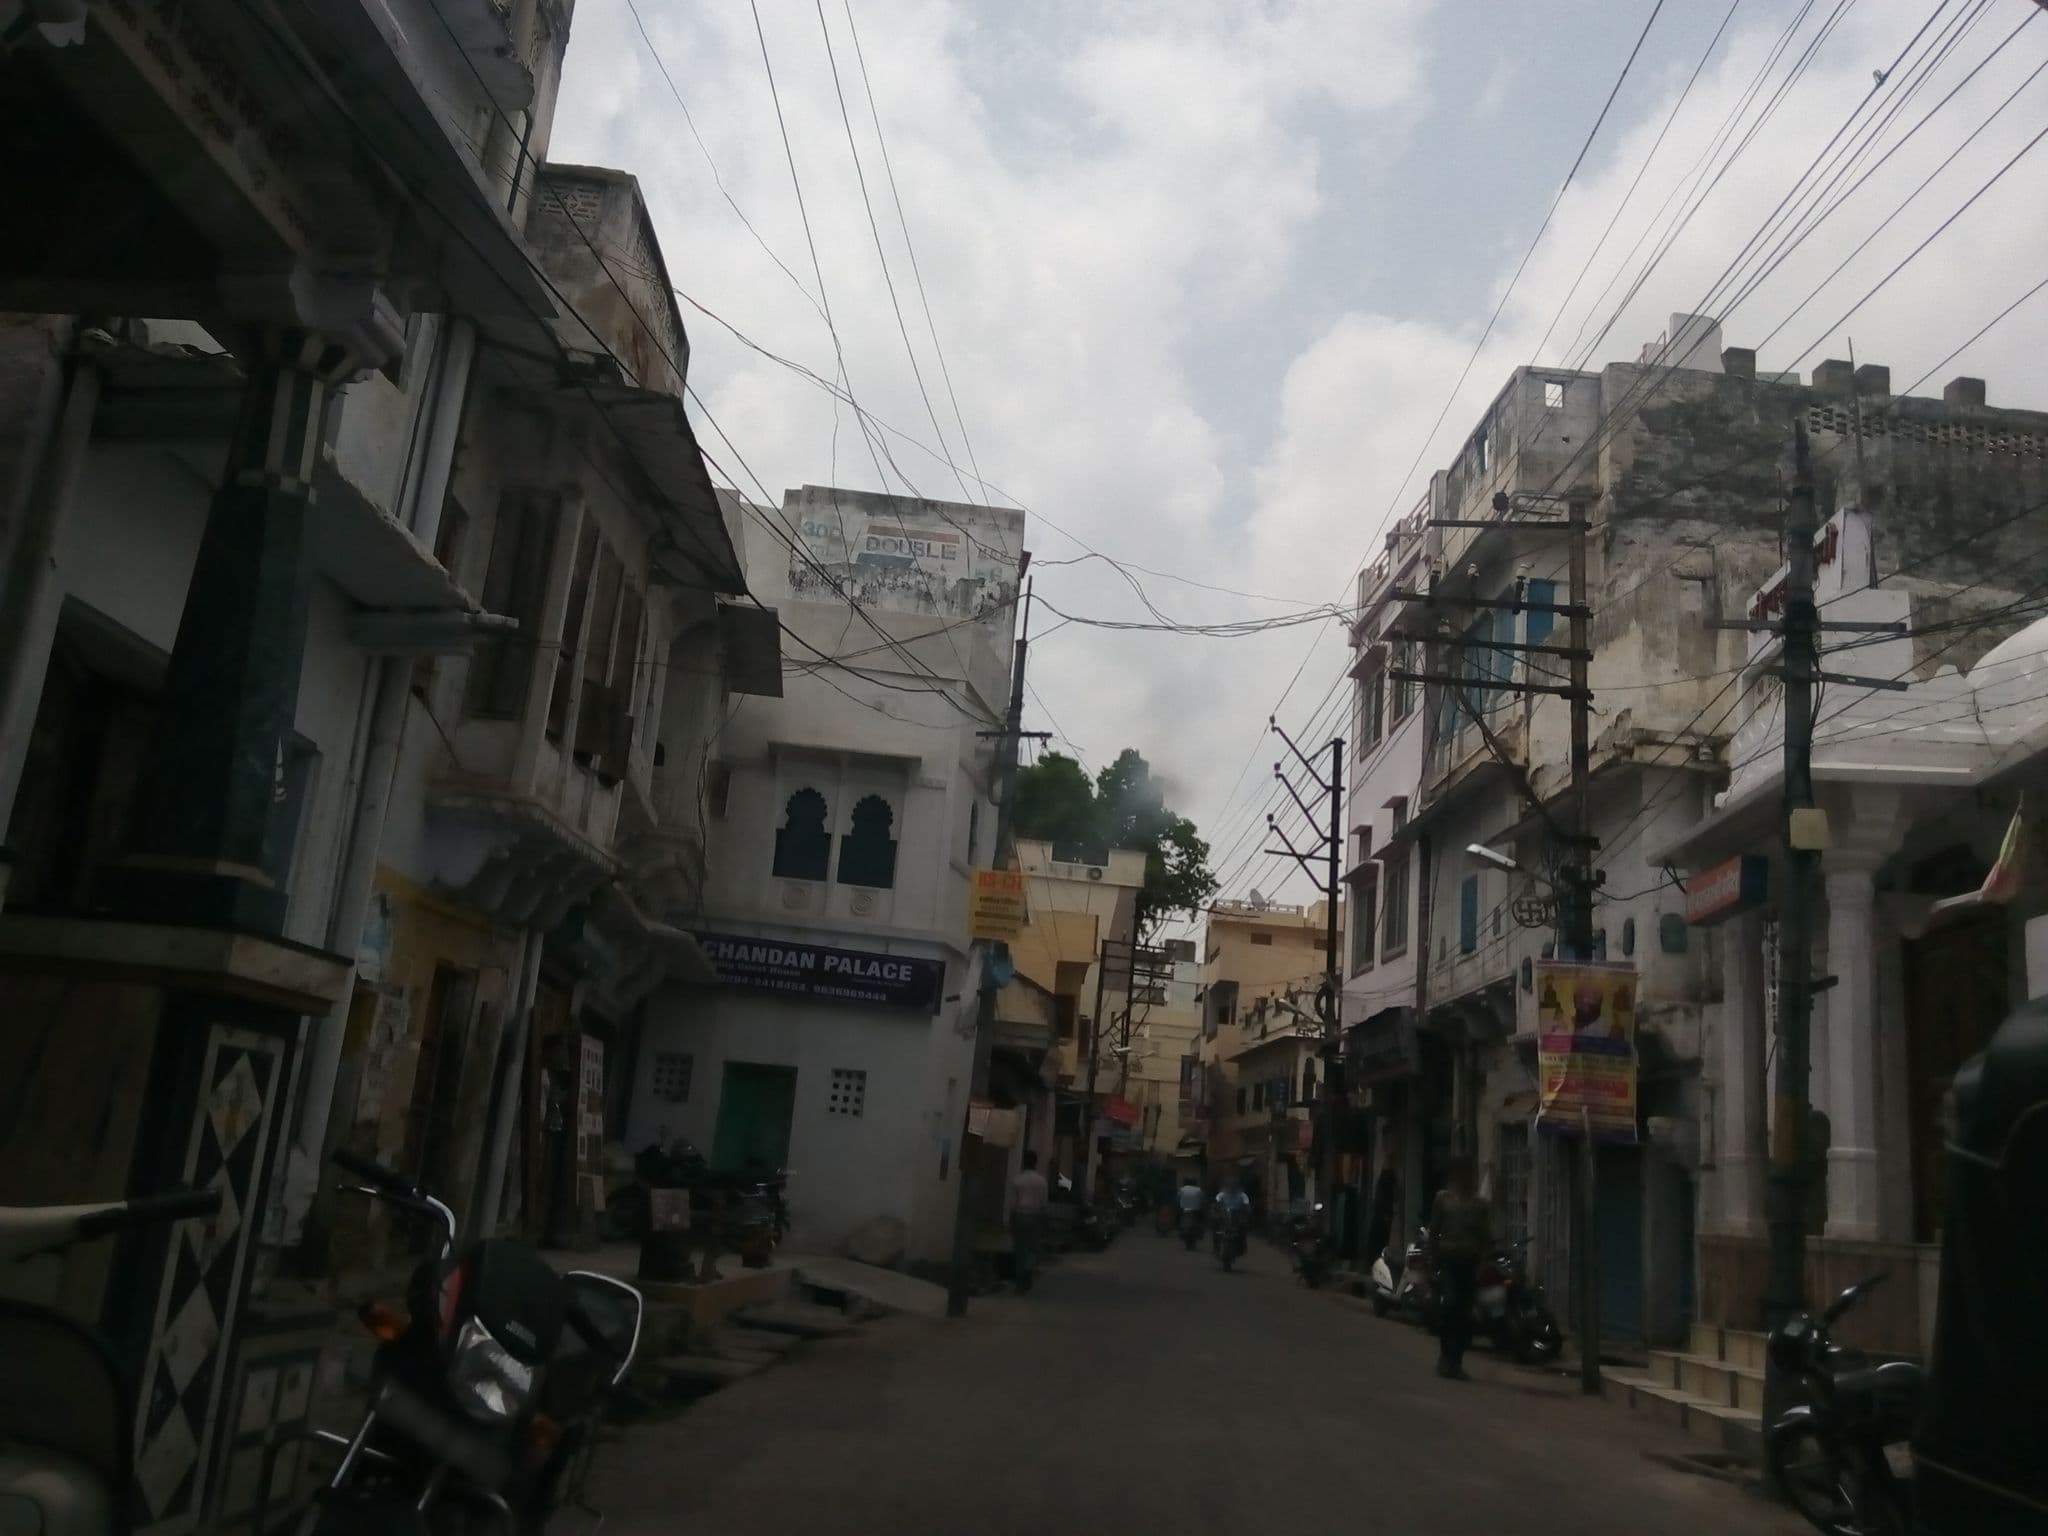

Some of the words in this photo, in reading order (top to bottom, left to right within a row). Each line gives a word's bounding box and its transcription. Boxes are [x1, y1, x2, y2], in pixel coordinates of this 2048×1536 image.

[866, 536, 957, 561] DOUBLE
[703, 940, 816, 969] CHANDAN
[824, 954, 913, 982] PALACE
